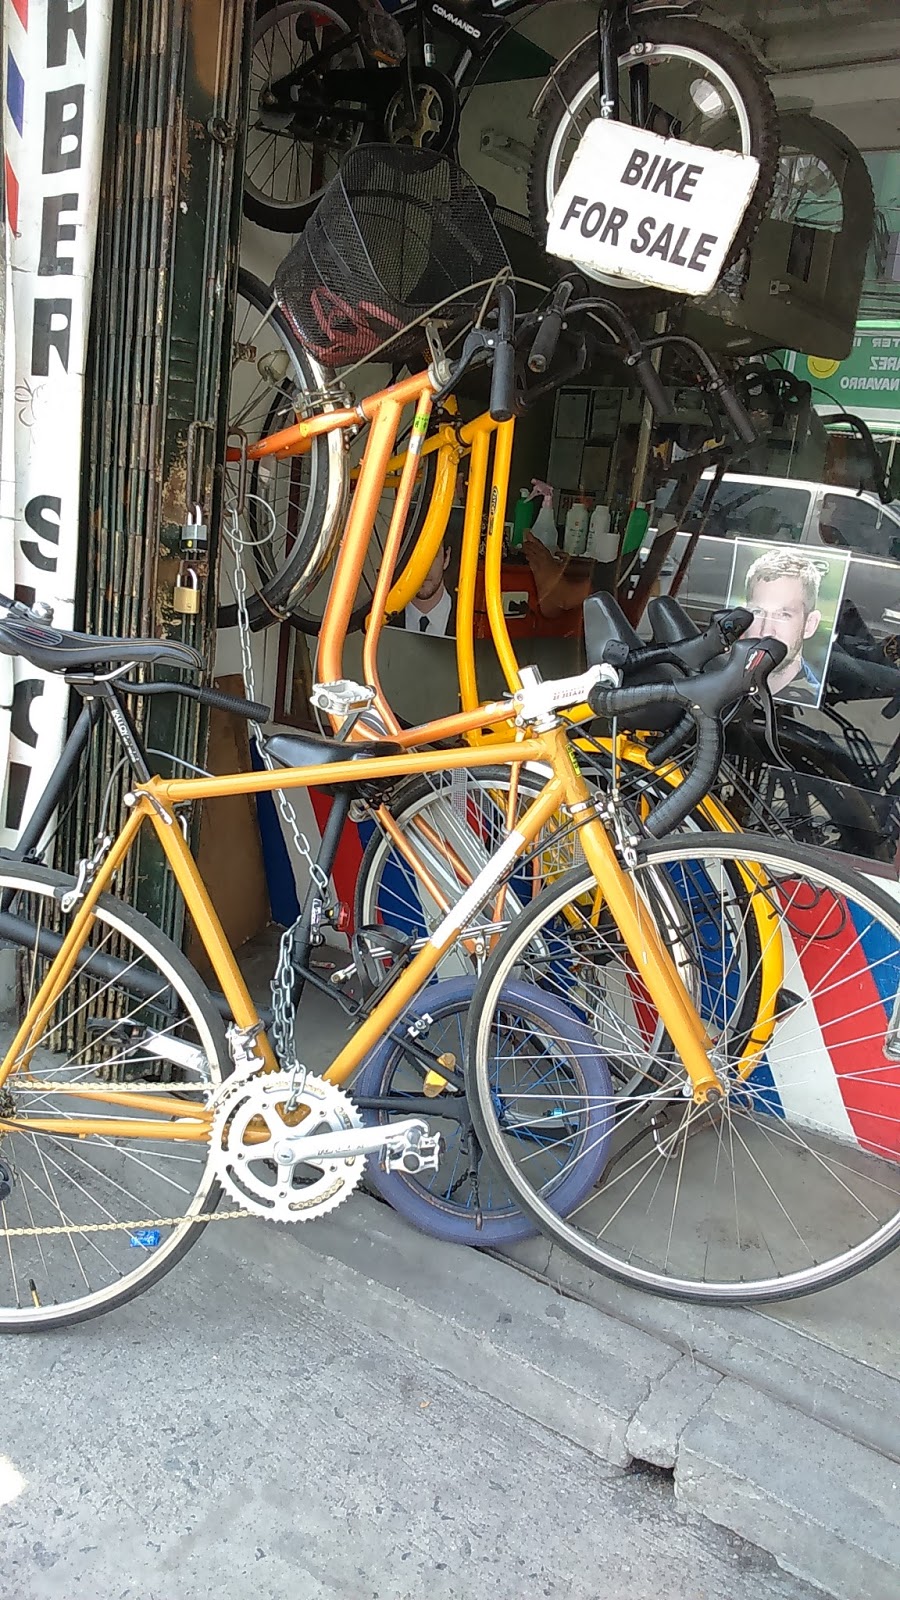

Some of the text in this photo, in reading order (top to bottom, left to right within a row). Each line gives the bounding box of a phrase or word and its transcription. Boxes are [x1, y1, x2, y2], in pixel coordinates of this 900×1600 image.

[432, 4, 482, 39] COMMANDO
[620, 148, 705, 203] BIKE
[559, 195, 718, 273] FOR SALE
